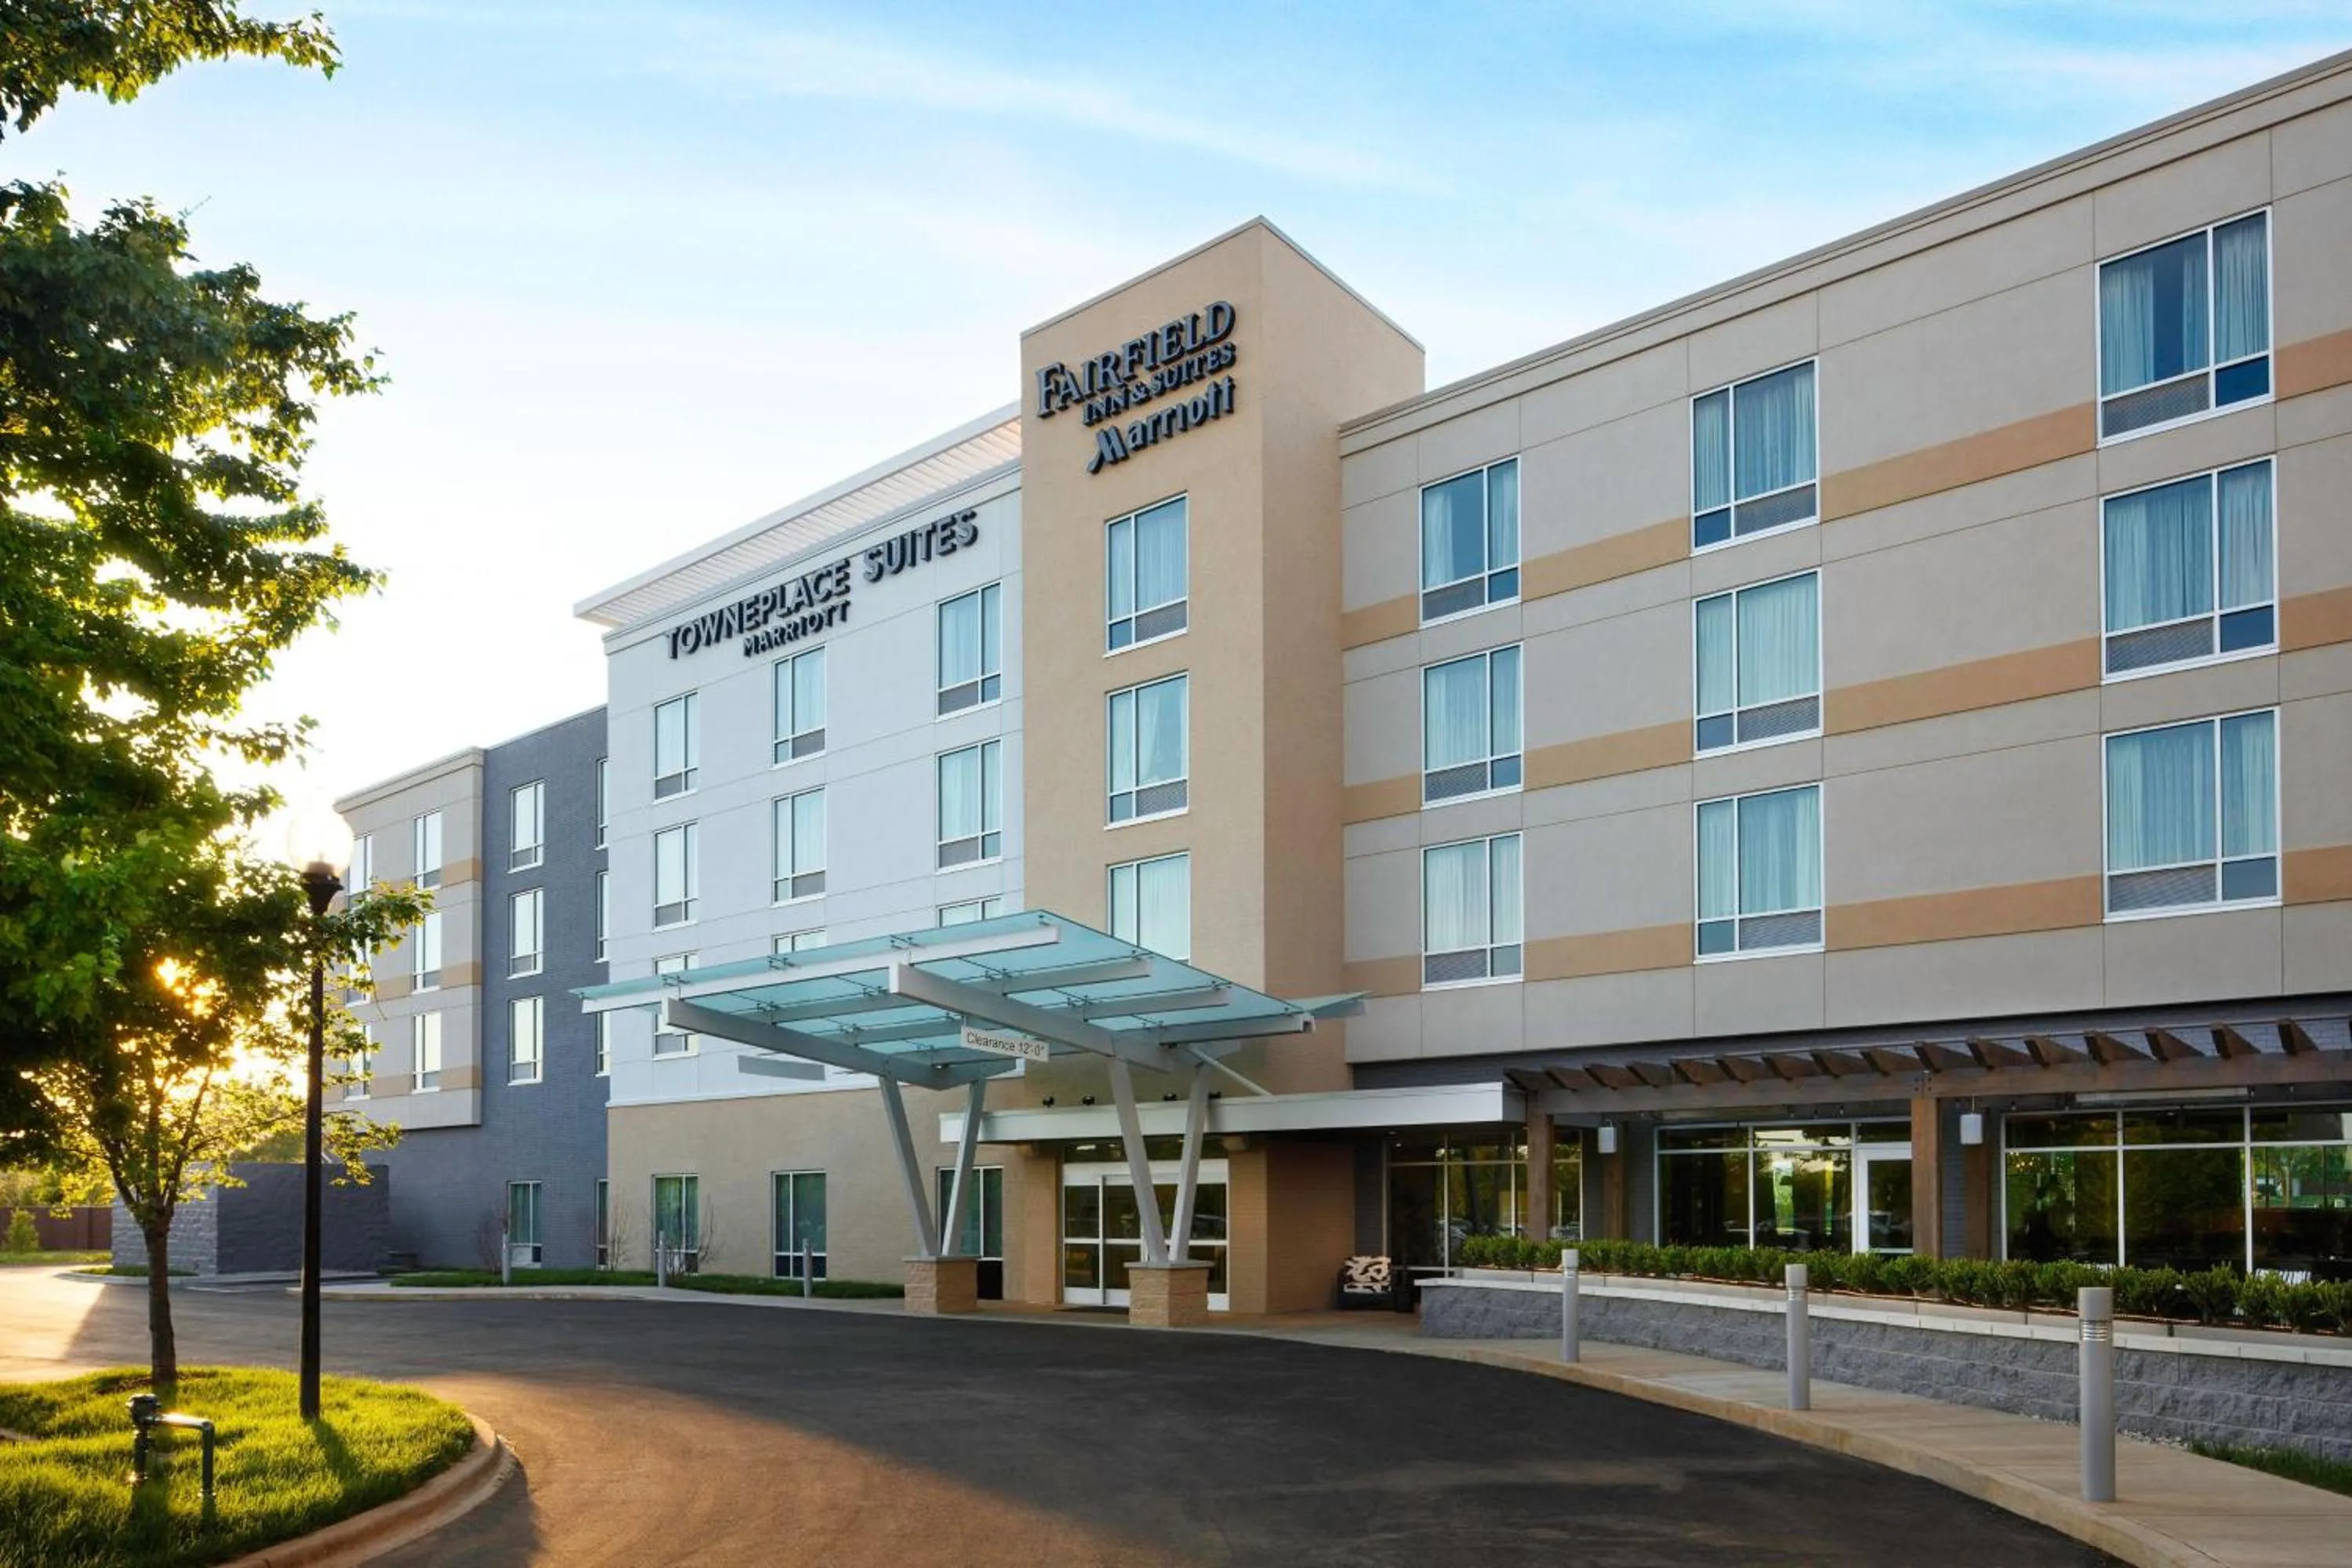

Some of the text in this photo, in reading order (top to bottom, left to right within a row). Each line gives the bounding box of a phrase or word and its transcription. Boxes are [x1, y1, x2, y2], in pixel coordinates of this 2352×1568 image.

[1035, 301, 1236, 419] FAIRFIELD
[1083, 390, 1130, 426] INN
[1150, 341, 1236, 396] SUITES
[1087, 374, 1236, 474] Marriott
[666, 510, 979, 659] TOWNEPLACE SUITES
[743, 600, 851, 657] MARRIOTT
[966, 1031, 1016, 1051] Clearance
